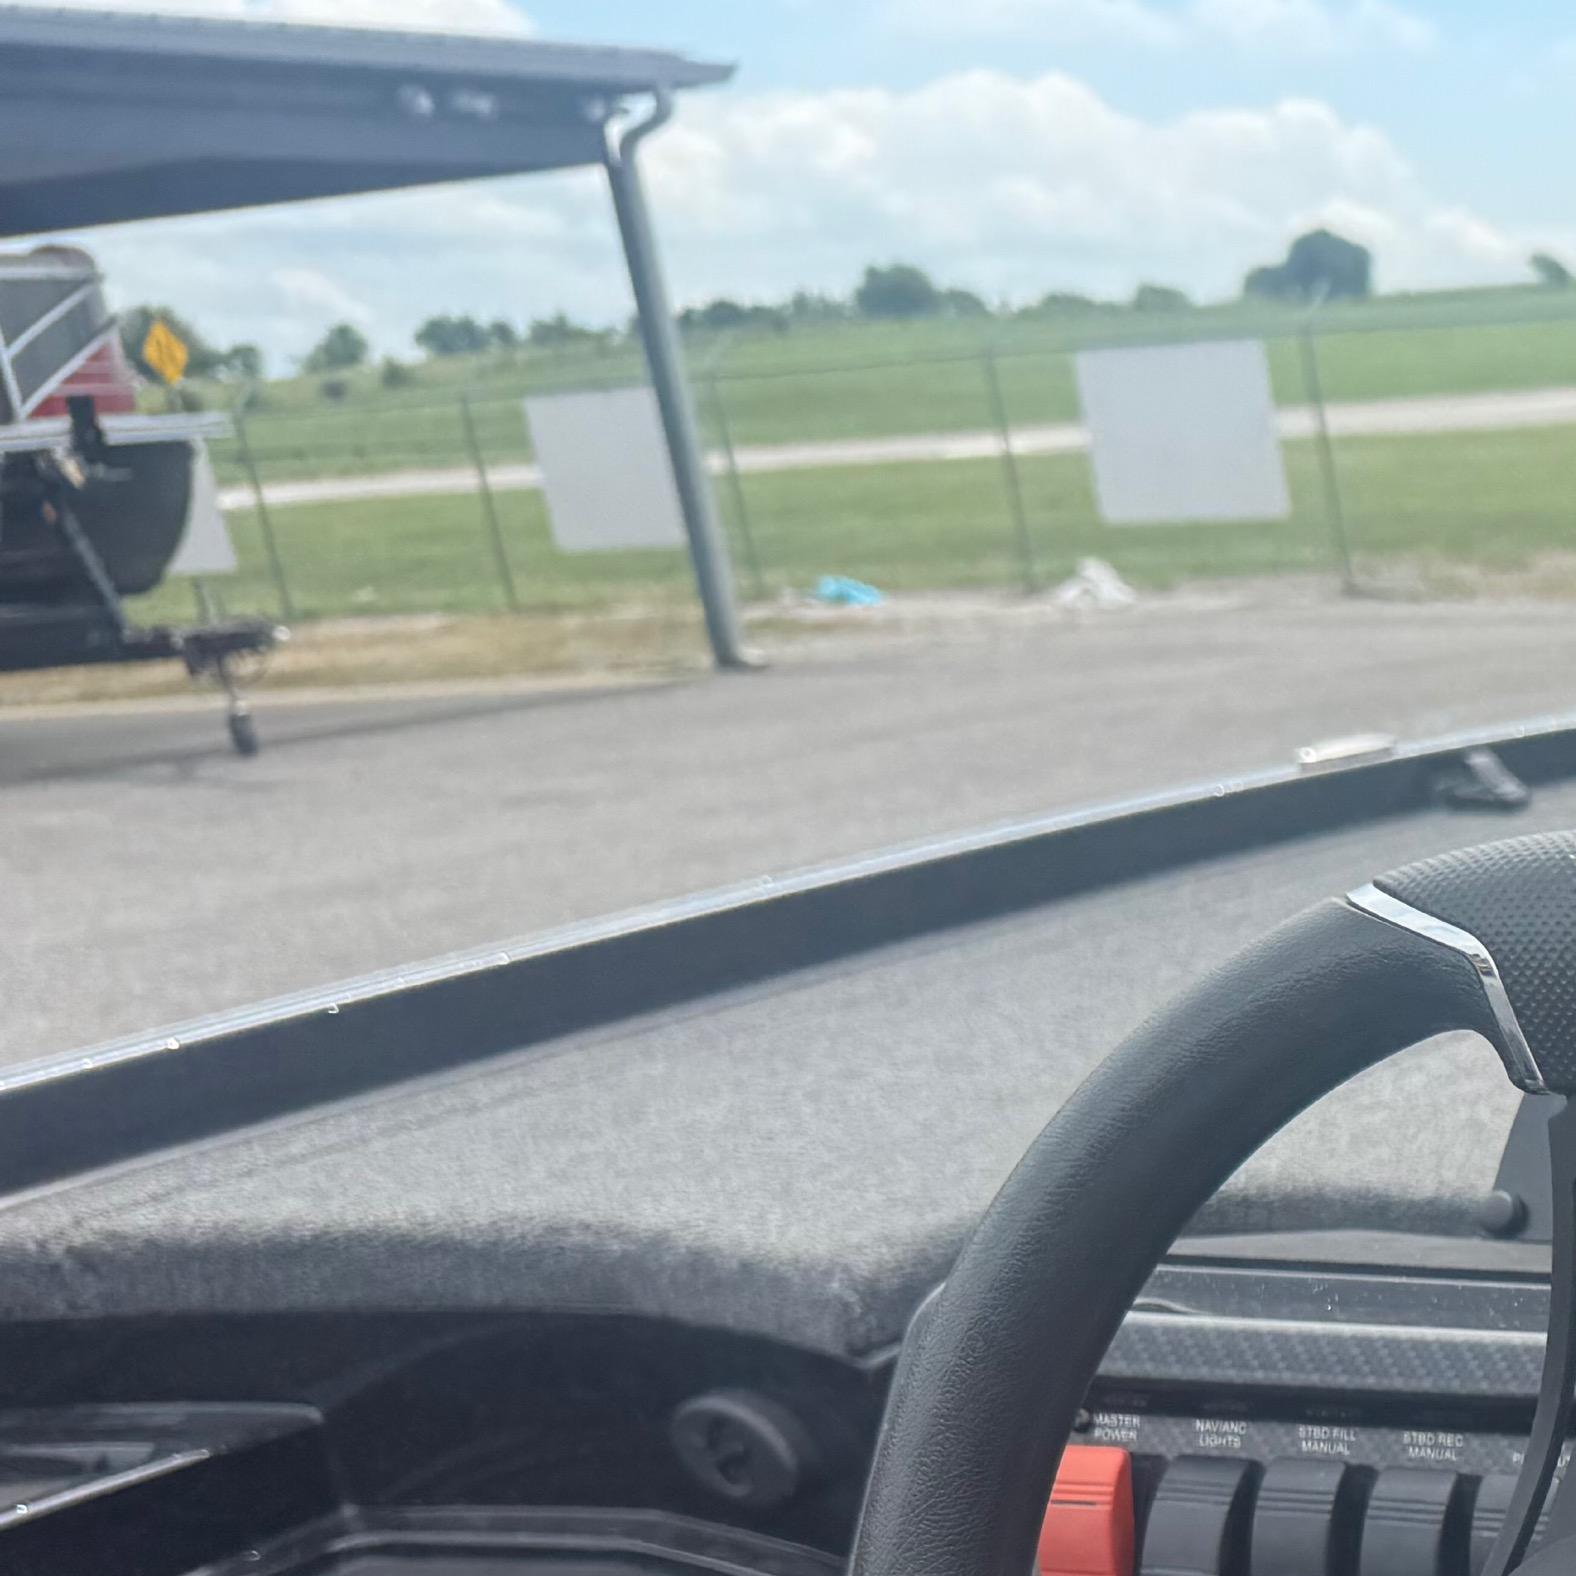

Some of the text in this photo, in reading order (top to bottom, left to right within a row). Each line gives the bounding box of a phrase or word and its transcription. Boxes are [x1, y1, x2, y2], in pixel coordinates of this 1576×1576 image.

[1093, 1413, 1141, 1428] MASTER
[1094, 1427, 1138, 1442] POWER
[1199, 1433, 1242, 1449] LIGHTS
[1299, 1426, 1356, 1441] STBD FILL
[1403, 1431, 1436, 1446] STBD
[1301, 1440, 1350, 1455] MANUAL
[1408, 1446, 1457, 1462] MANUAL
